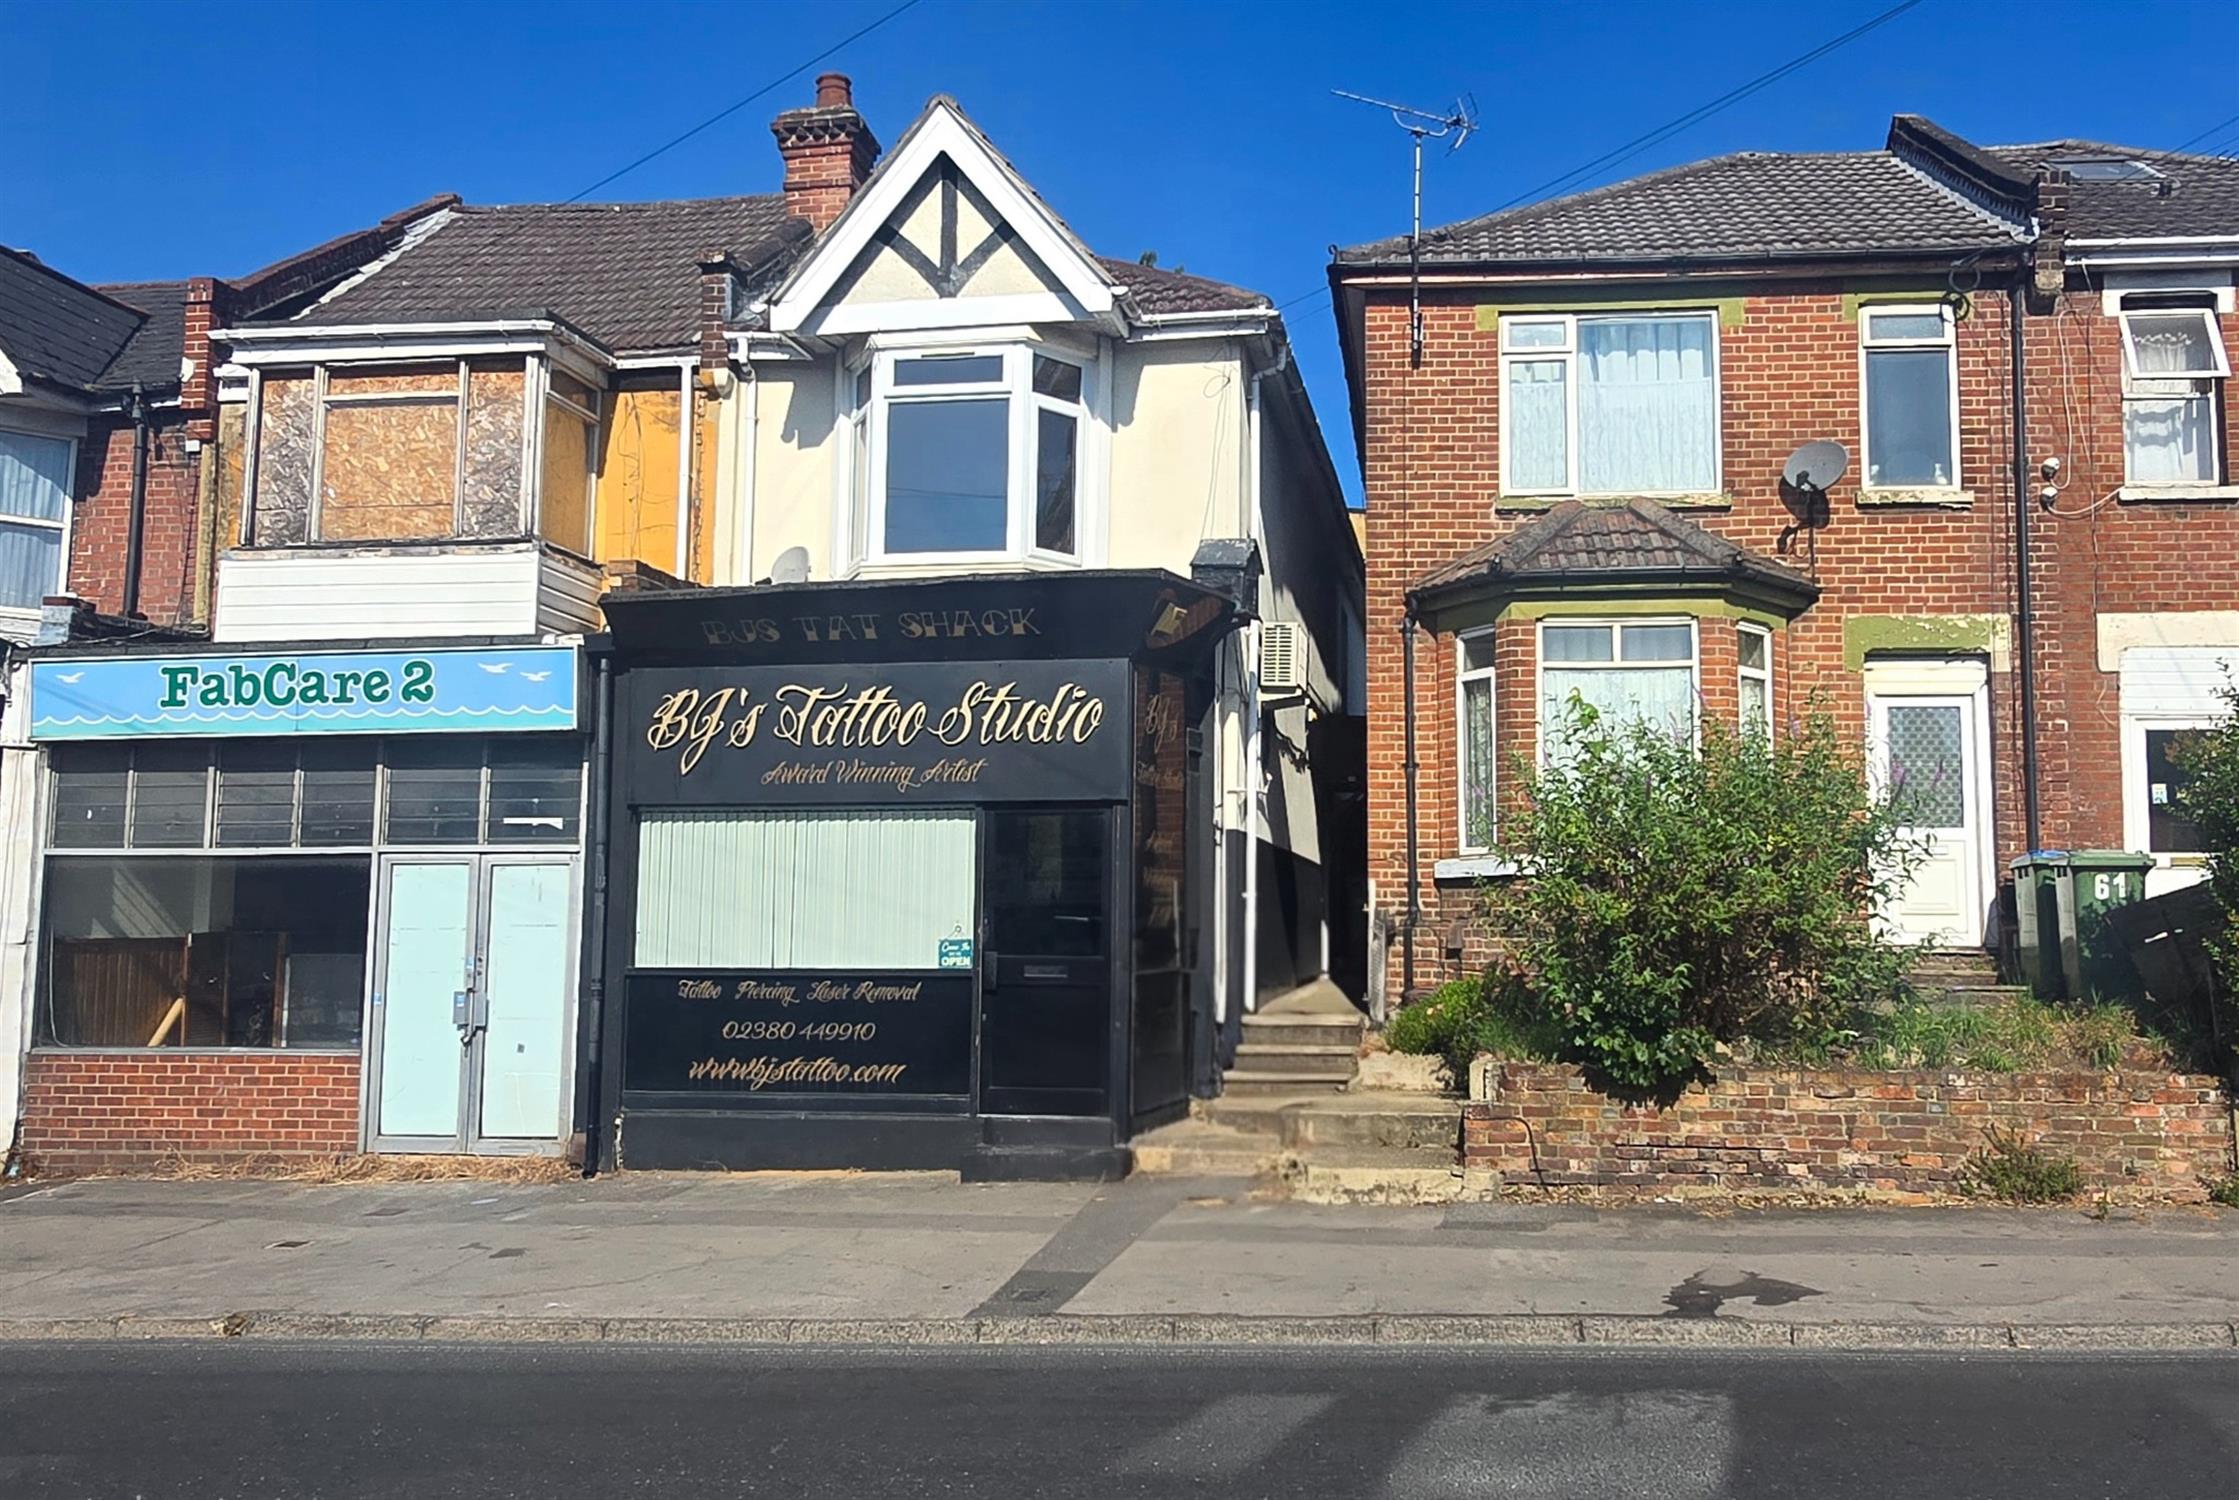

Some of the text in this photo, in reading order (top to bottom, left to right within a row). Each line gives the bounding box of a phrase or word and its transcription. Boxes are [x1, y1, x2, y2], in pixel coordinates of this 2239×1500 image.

[701, 608, 1041, 645] BJS TAT SHACK
[160, 661, 434, 708] FabCare 2
[646, 681, 1103, 776] BJ's Tattoo Studio
[761, 758, 987, 792] Award Winning Artist
[2095, 873, 2127, 899] 61
[941, 956, 971, 967] OPEN
[678, 979, 922, 1007] Tattoo Piercing Laser Removal
[722, 1020, 876, 1041] 02380 449910
